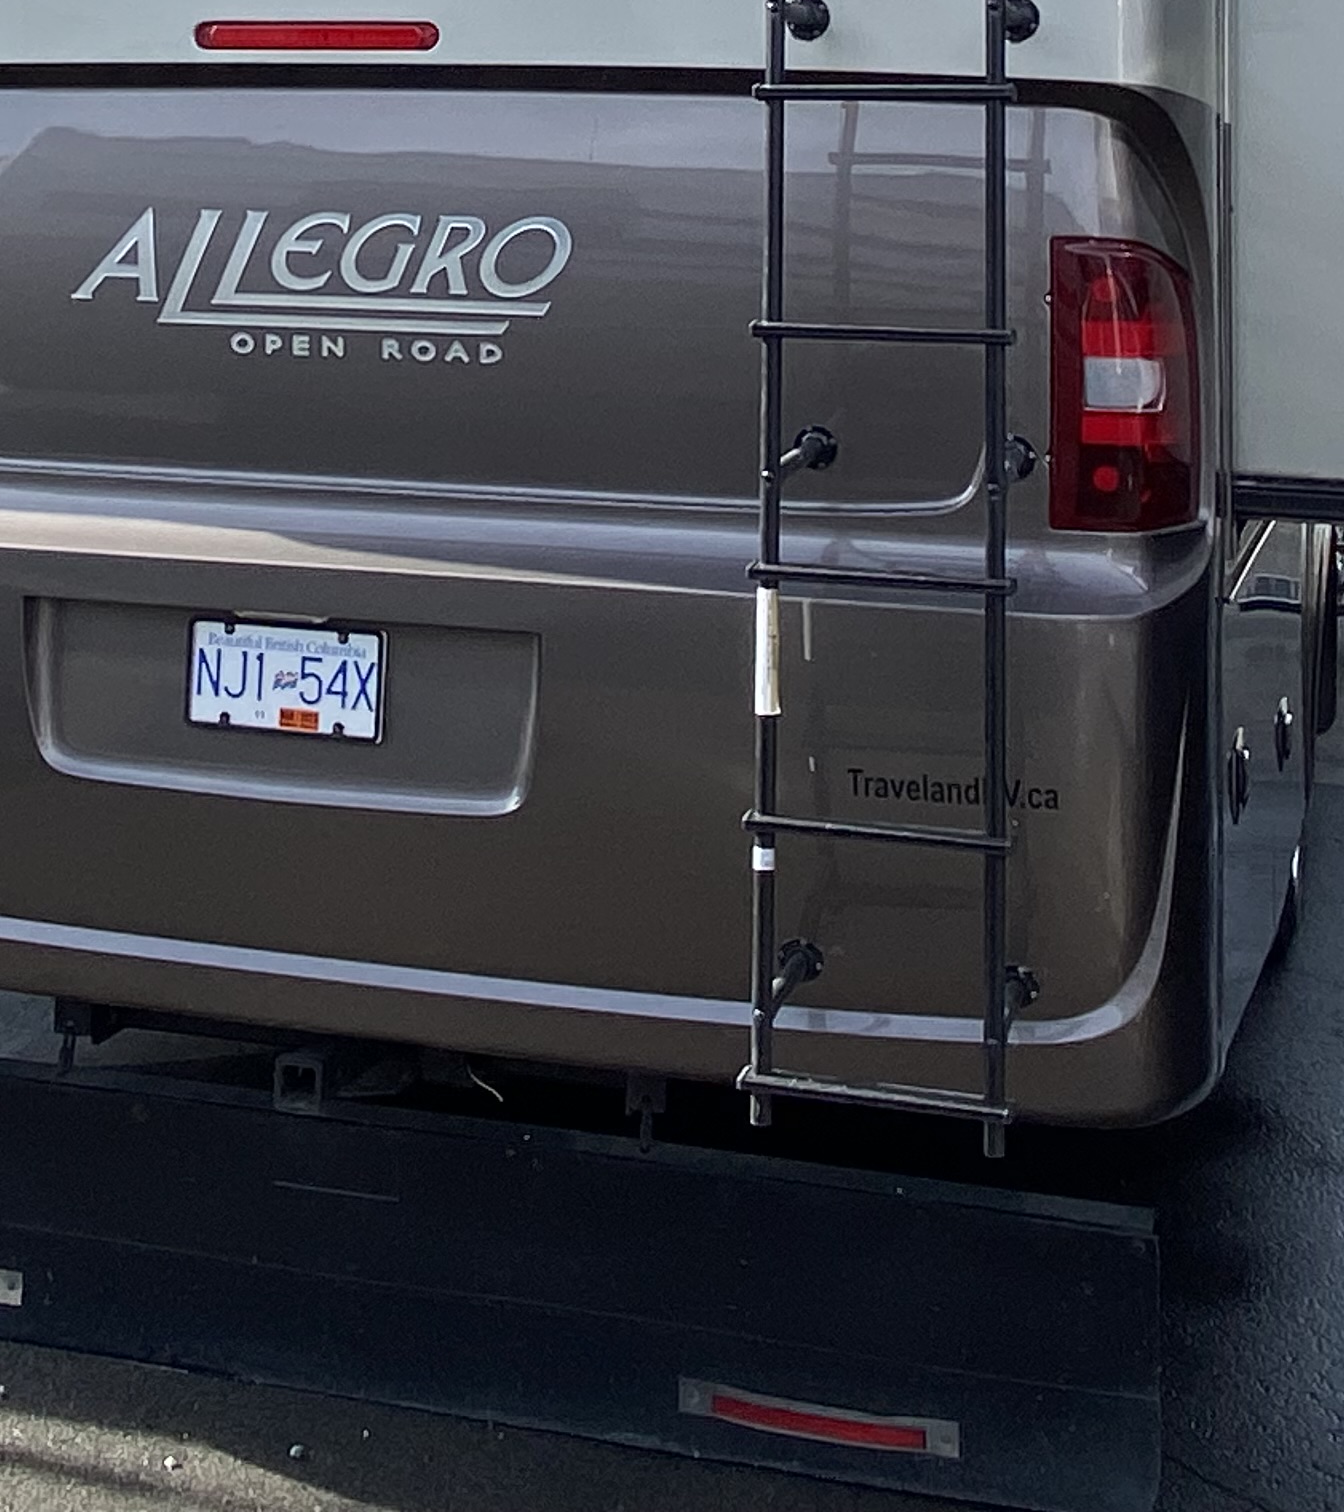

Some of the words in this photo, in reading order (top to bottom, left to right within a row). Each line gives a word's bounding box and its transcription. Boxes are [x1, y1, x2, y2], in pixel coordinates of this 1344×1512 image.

[70, 206, 573, 323] ALLEGRO
[230, 331, 346, 358] OPEN
[381, 337, 503, 365] ROAD
[847, 768, 1060, 810] TravelandV.ca
